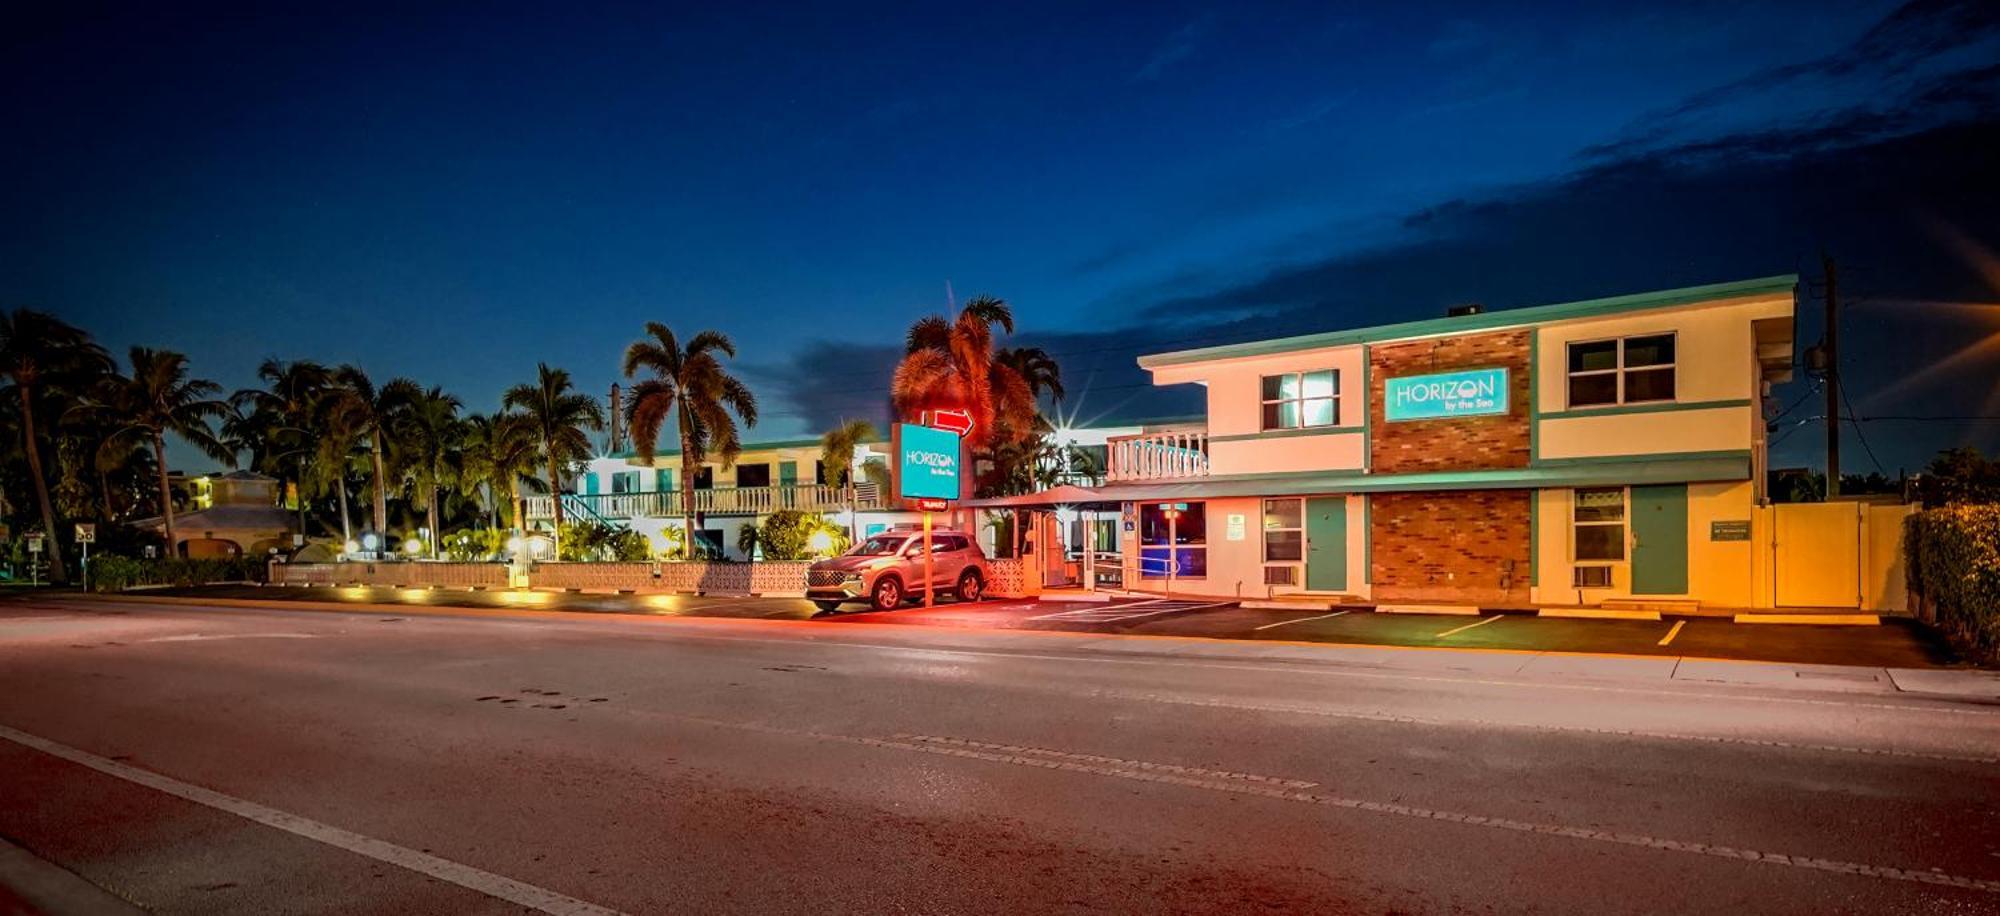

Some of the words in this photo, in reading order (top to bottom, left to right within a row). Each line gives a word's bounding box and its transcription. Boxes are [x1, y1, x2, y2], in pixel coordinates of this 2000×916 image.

[1397, 375, 1494, 406] HORIZON
[1445, 401, 1457, 412] by
[1458, 399, 1474, 410] the
[1476, 398, 1494, 409] Sea
[906, 450, 955, 466] HORIZON
